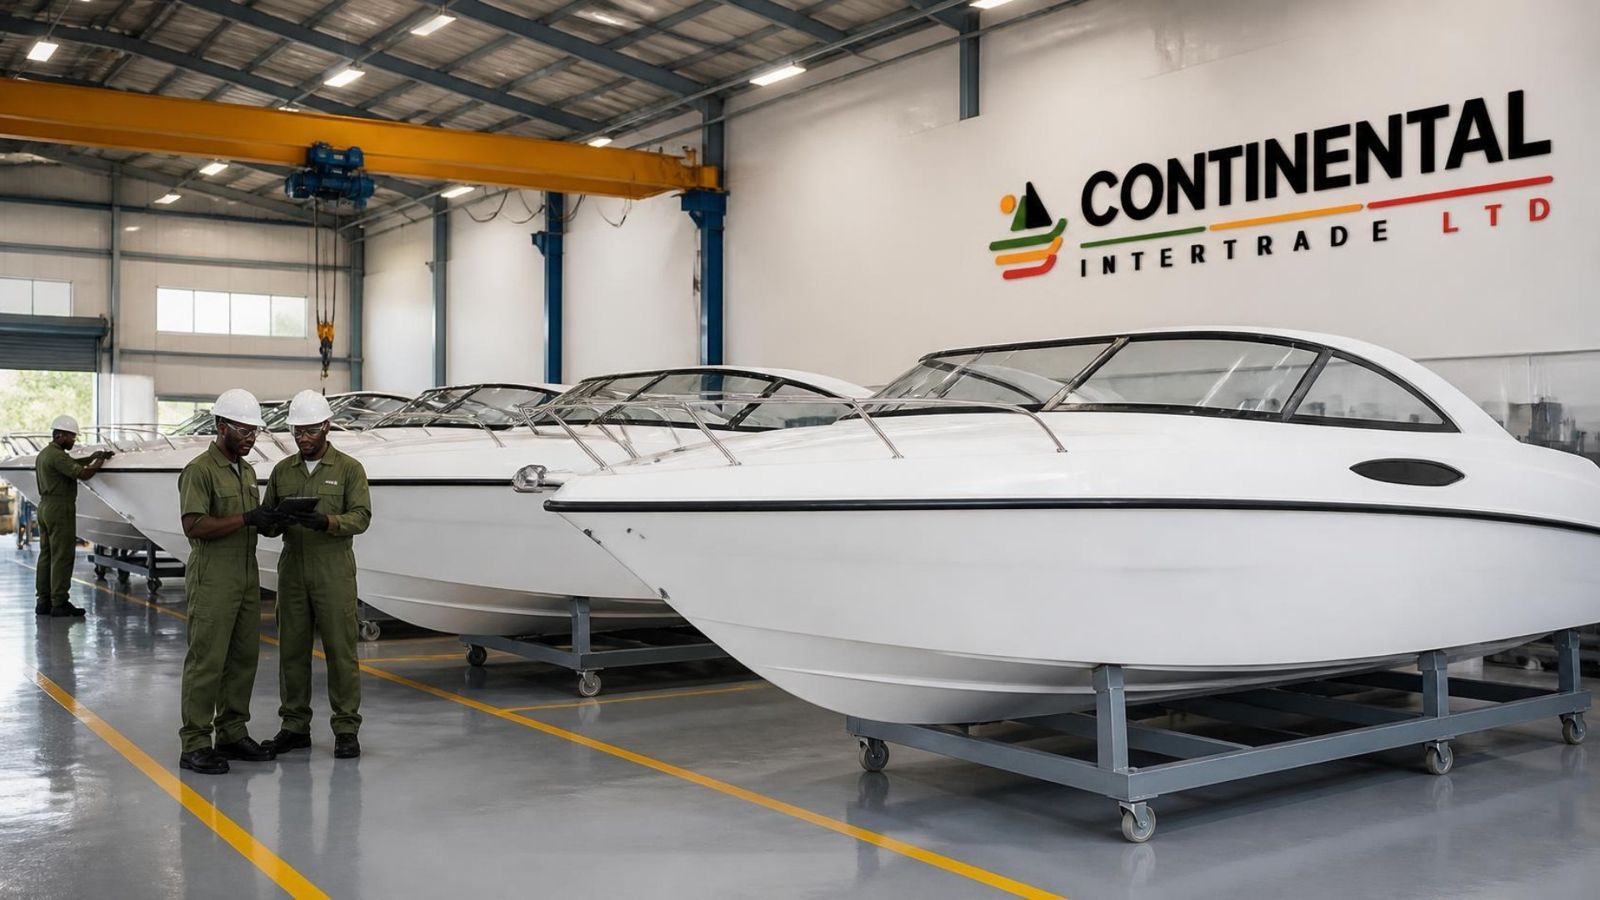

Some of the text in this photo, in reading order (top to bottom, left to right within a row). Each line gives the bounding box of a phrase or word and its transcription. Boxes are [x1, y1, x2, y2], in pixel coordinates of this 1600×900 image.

[1081, 89, 1552, 227] CONTINENTAL
[1080, 198, 1551, 278] INTERTRADE LTD
